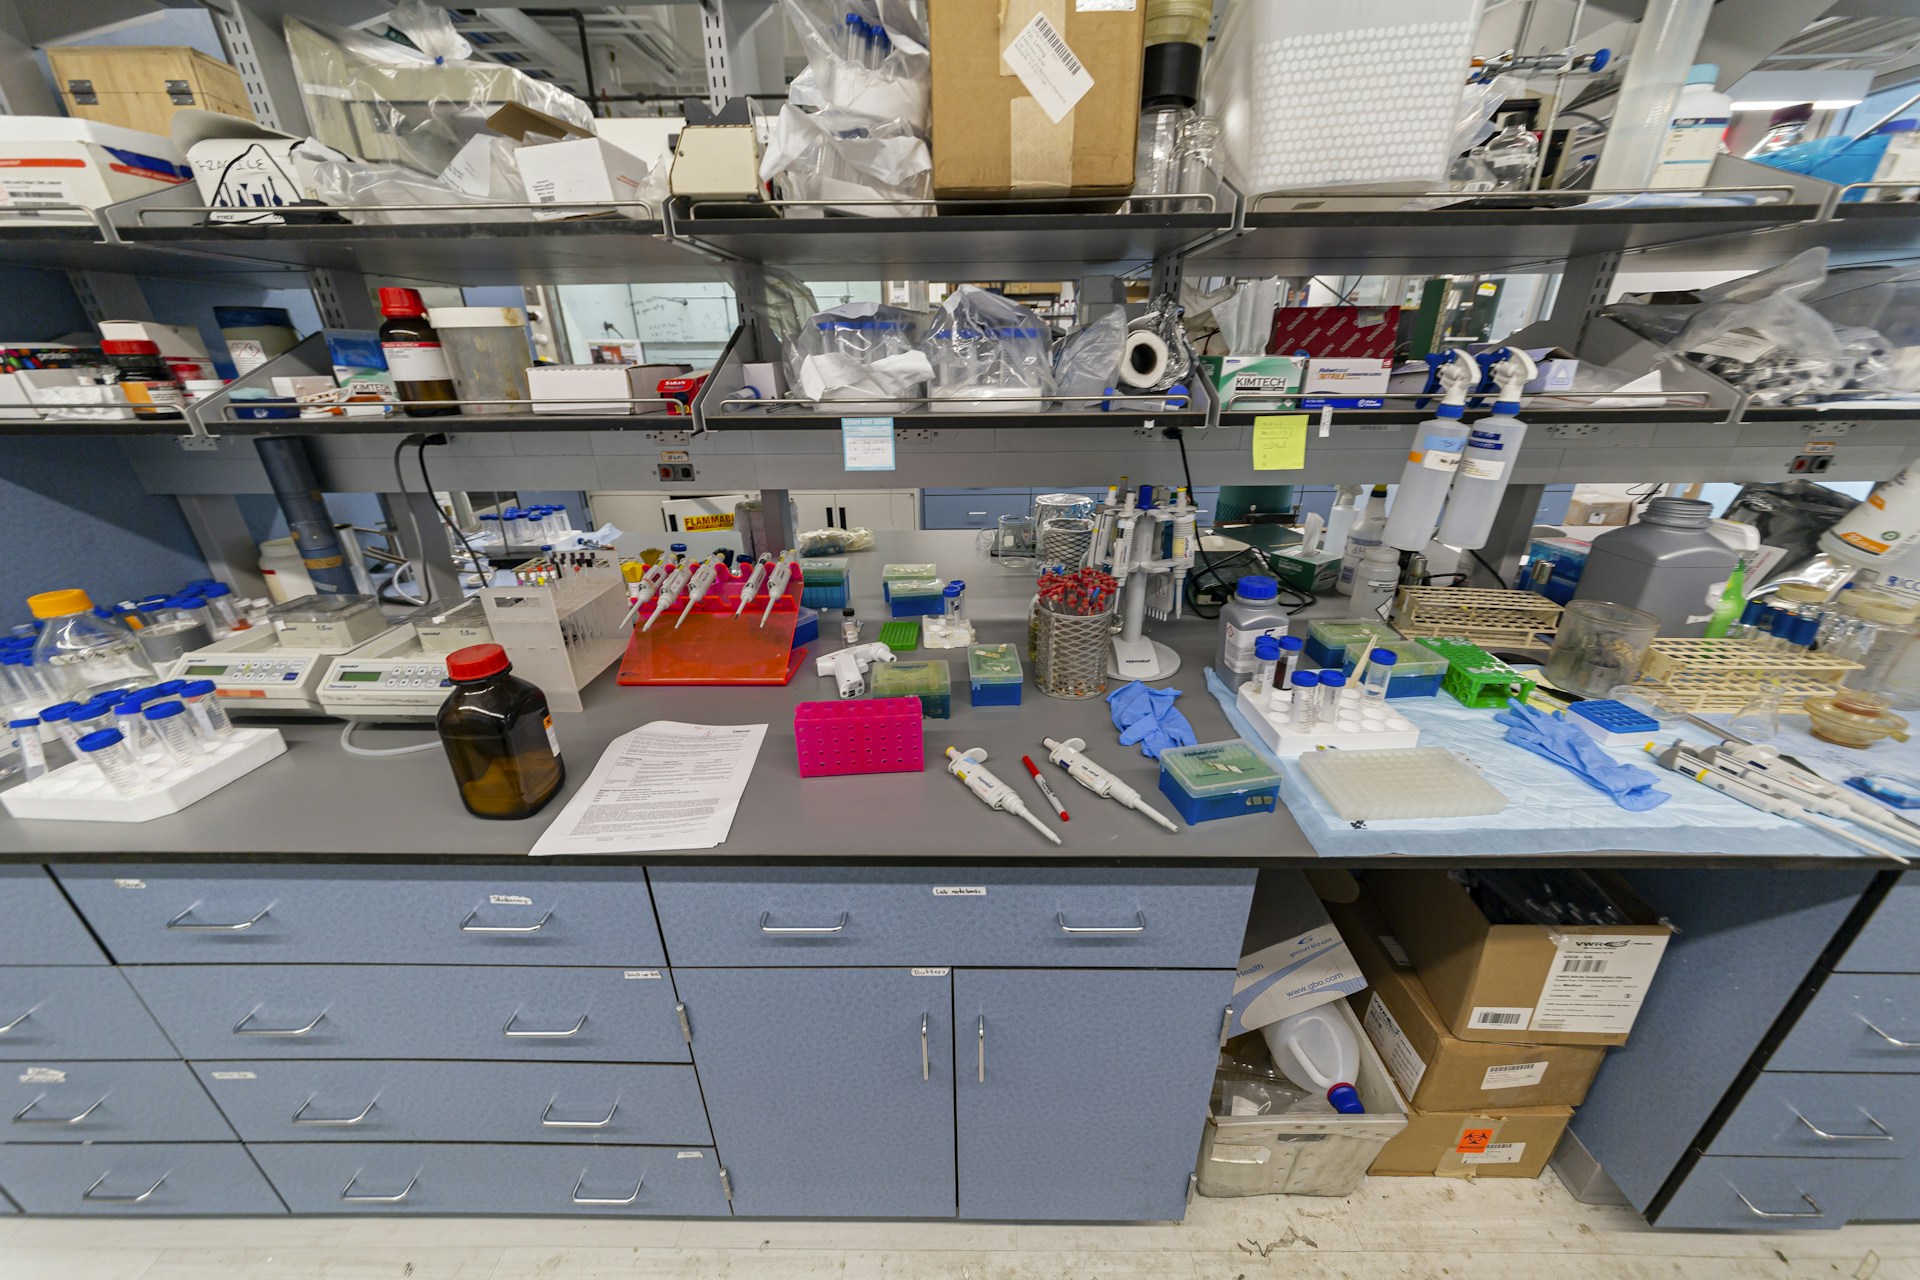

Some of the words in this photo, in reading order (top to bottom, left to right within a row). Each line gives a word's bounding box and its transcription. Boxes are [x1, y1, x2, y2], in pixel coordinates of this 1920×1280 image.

[1235, 377, 1286, 387] KIMTECH
[1236, 963, 1264, 978] Health
[1286, 972, 1344, 998] www.gbo.com
